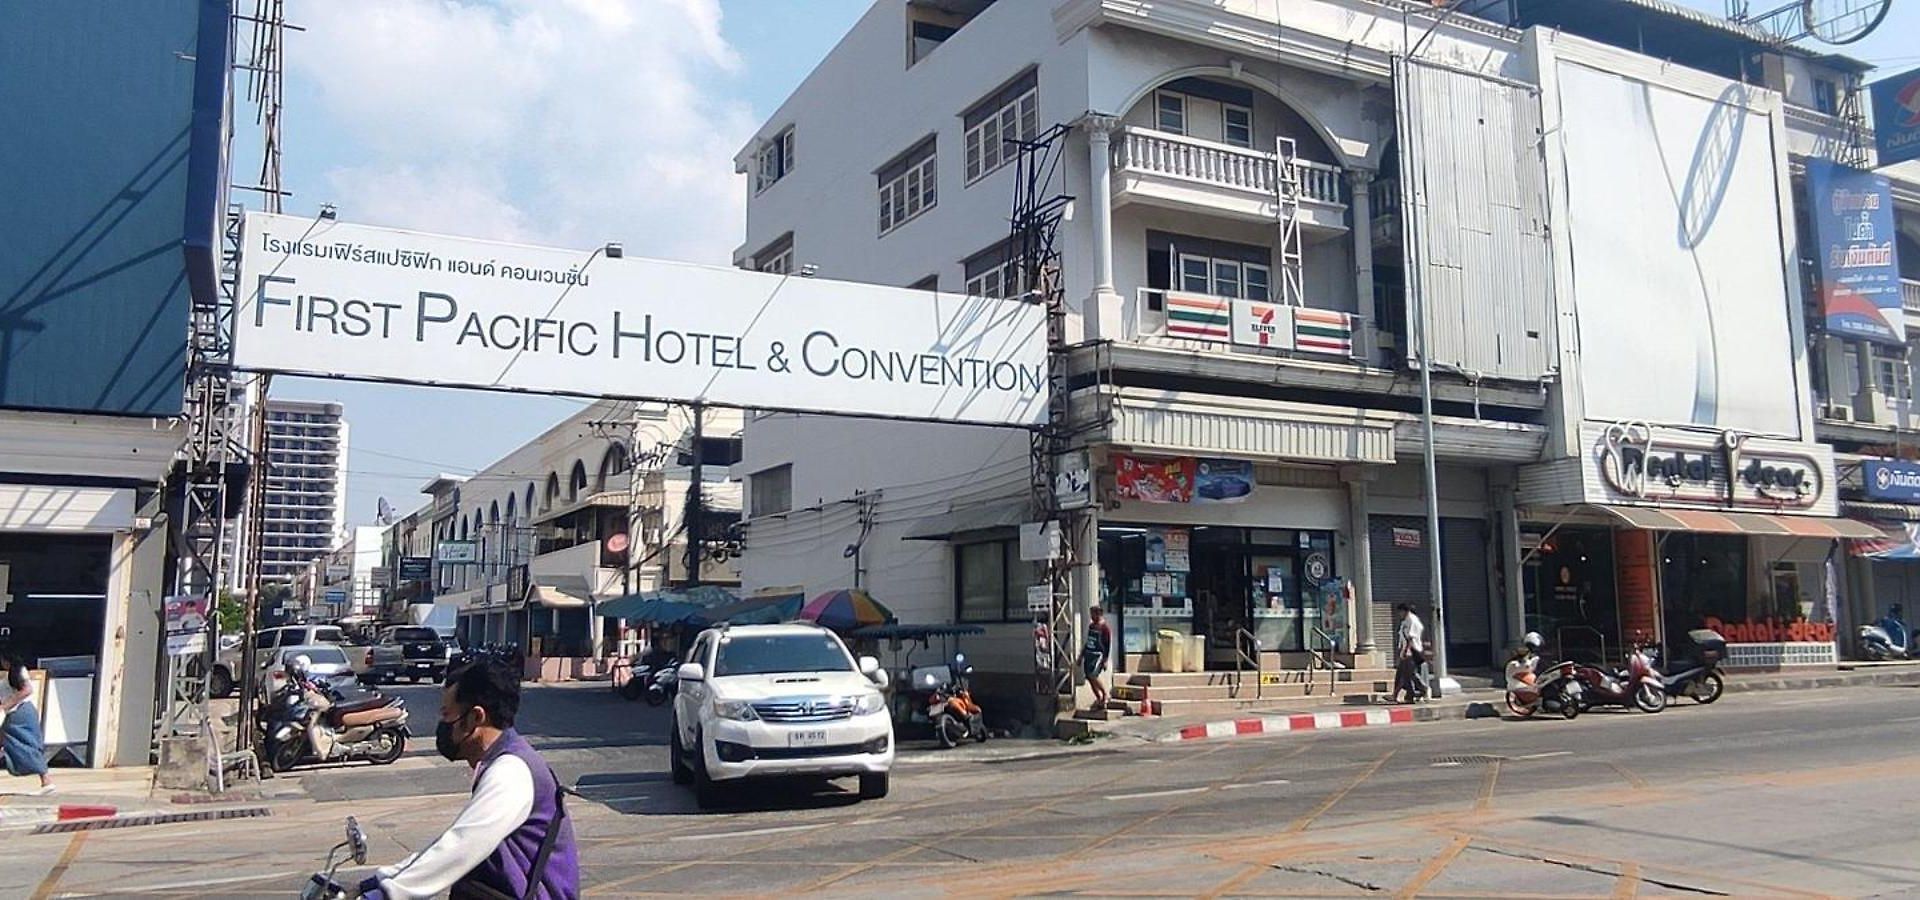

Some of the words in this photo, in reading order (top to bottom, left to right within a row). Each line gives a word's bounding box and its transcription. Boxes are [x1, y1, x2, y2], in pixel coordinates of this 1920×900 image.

[261, 232, 442, 273] โรงแรมเฟิร์สแปซิฟิก
[448, 257, 496, 278] แอนด์
[501, 263, 590, 287] คอนเวนชั่น
[254, 273, 402, 340] FIRST
[415, 290, 598, 357] PACIFIC
[612, 310, 757, 370] HOTEL
[766, 340, 792, 374] &
[801, 329, 1042, 394] CONVENTION
